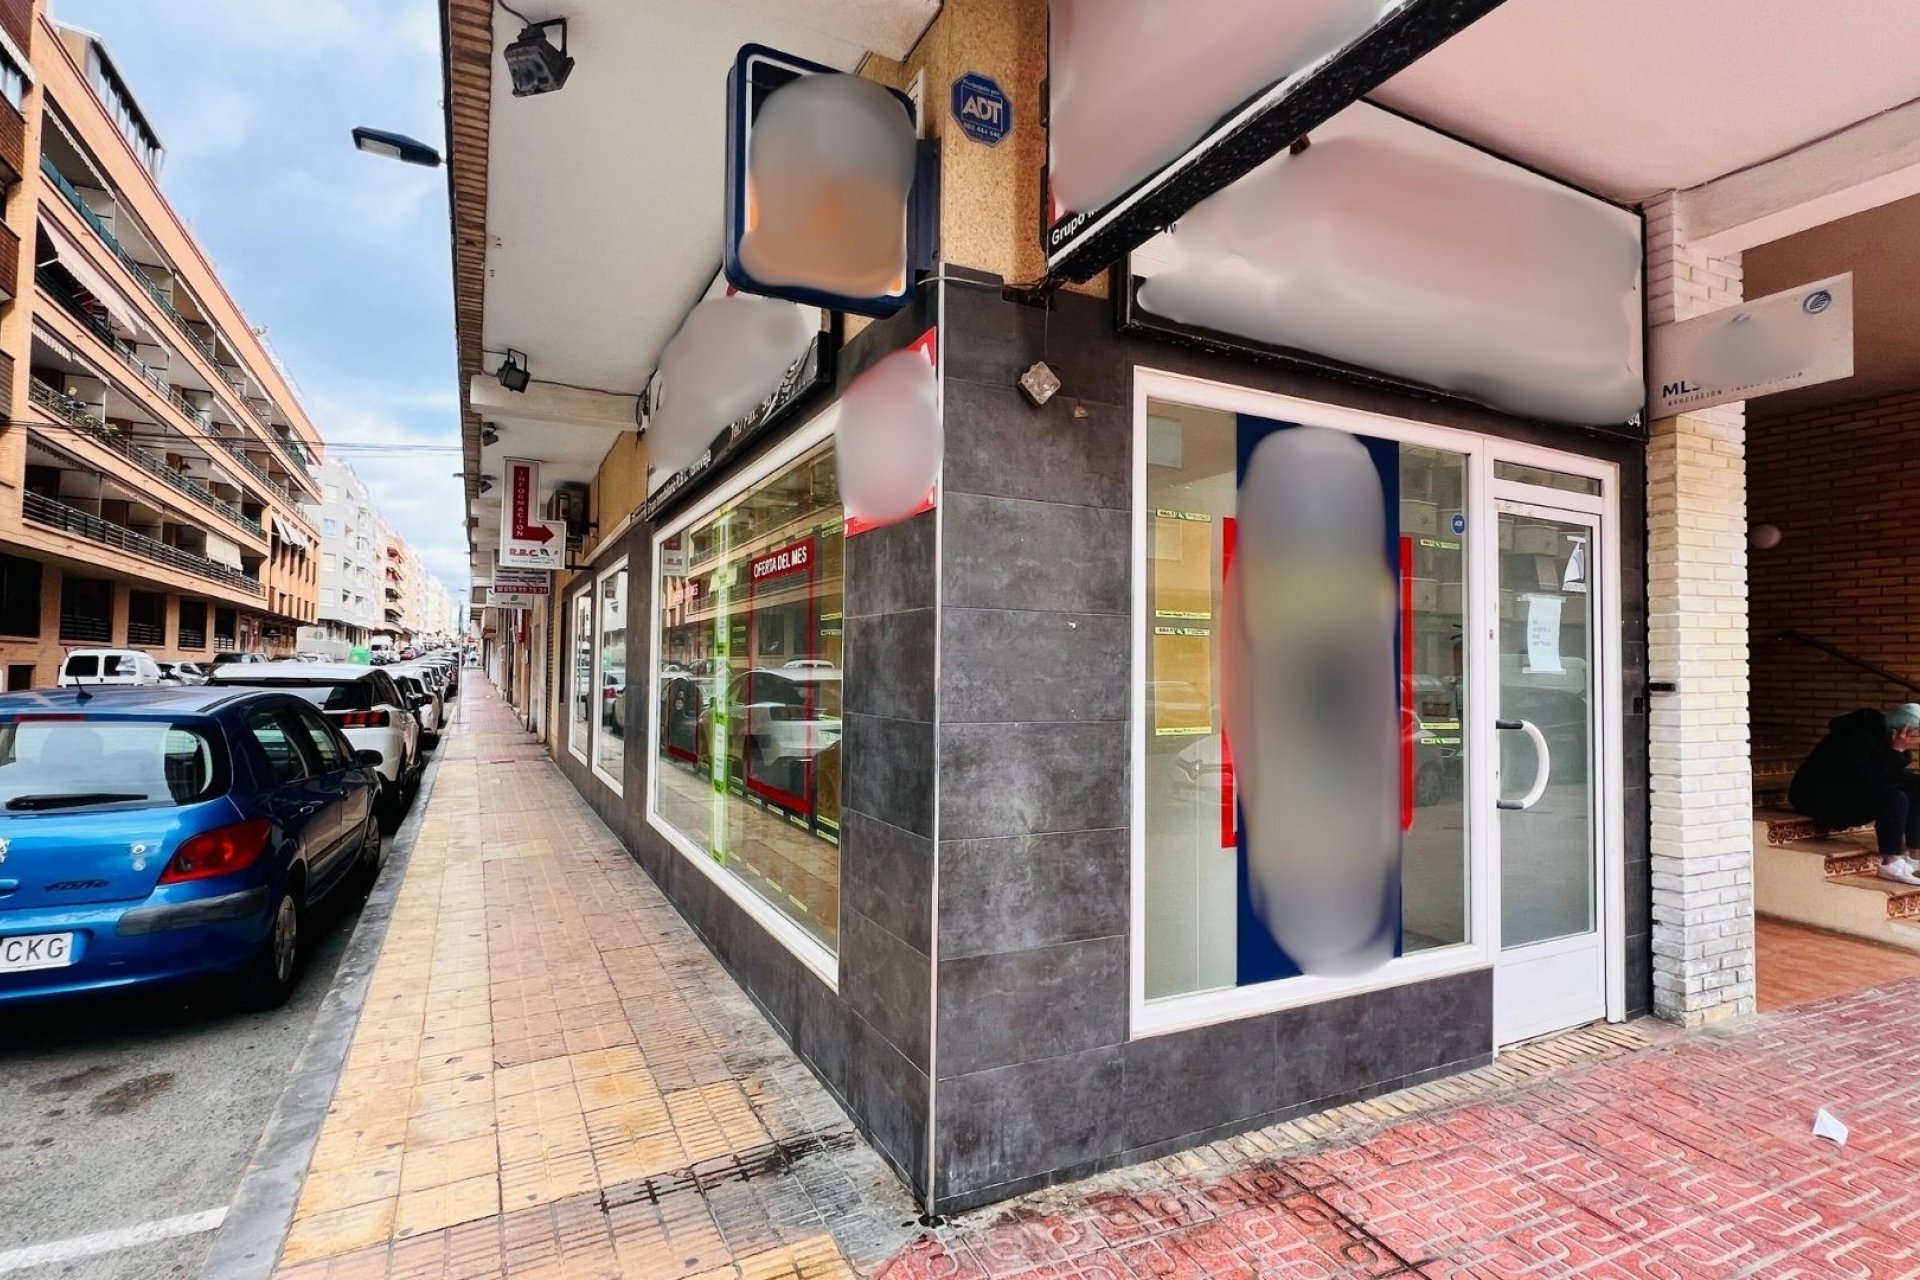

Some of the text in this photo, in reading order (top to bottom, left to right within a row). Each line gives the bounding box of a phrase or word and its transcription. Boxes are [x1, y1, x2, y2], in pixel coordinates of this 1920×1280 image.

[962, 95, 1002, 124] ADT
[1051, 212, 1085, 245] Grupo
[753, 546, 807, 578] OFERTA DEL MES
[6, 937, 64, 962] CKG
